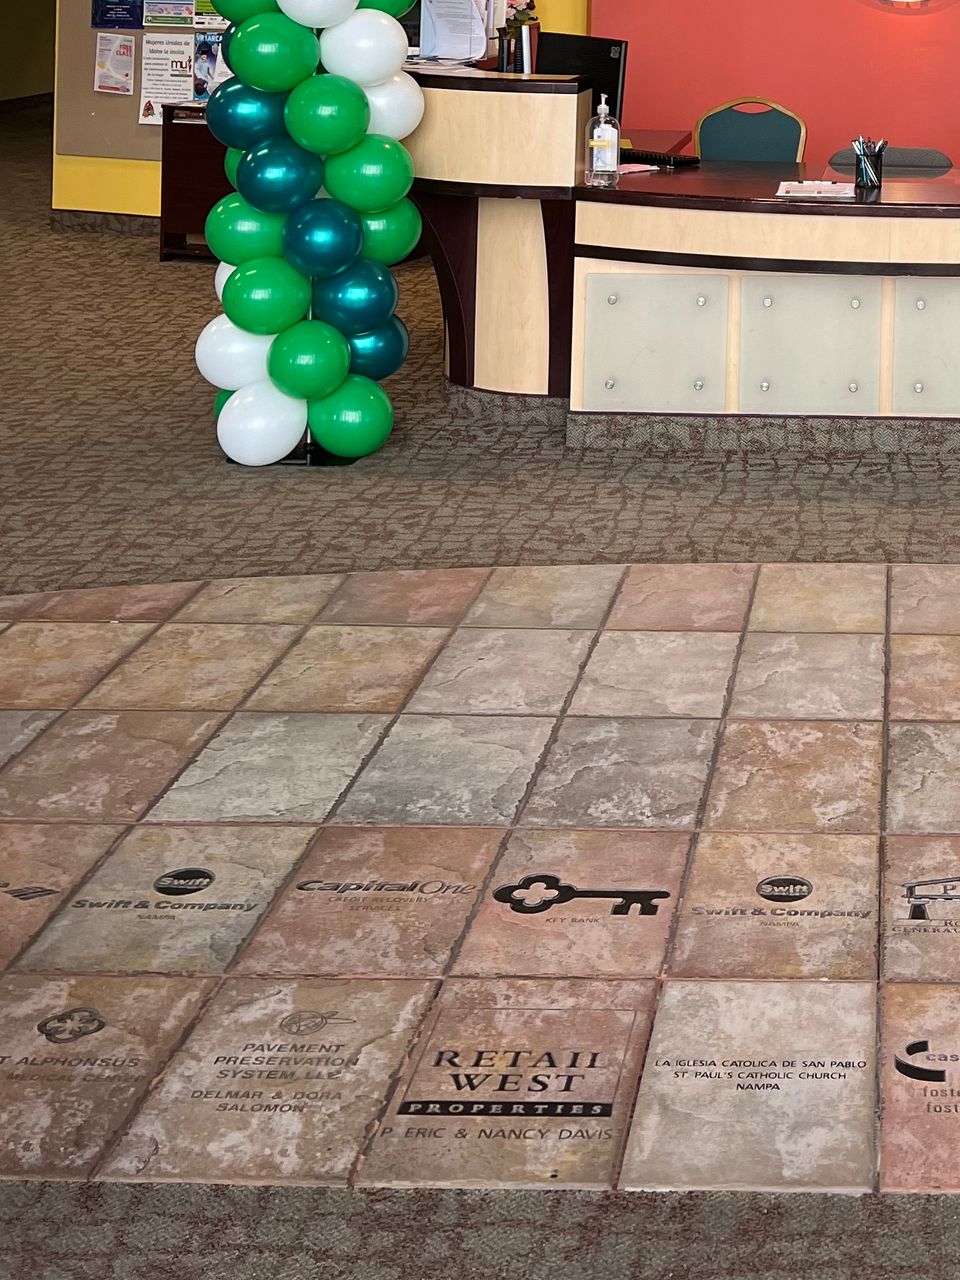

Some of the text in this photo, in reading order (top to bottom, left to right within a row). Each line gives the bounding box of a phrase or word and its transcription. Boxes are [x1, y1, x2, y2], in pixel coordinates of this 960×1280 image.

[159, 877, 210, 888] Swift
[760, 884, 808, 894] Swift
[72, 899, 259, 912] Swift & Company
[691, 906, 747, 916] Swift
[770, 908, 871, 919] Company
[242, 1044, 345, 1053] PAVEMENT
[15, 1056, 141, 1067] ALPHONSUS
[214, 1056, 359, 1066] PRESERVATION
[830, 1060, 867, 1068] PABLO
[6, 1073, 146, 1083] MEDICAL CENTER
[216, 1070, 295, 1079] SYSTEM
[450, 1073, 585, 1092] WEST
[190, 1090, 342, 1100] DELMAR & DORA
[216, 1103, 305, 1112] SALOMON
[408, 1104, 602, 1114] PROPERTIES
[404, 1128, 447, 1138] ERIC
[454, 1129, 468, 1138] &
[477, 1128, 551, 1140] NANCY
[558, 1129, 612, 1140] DAVIS
